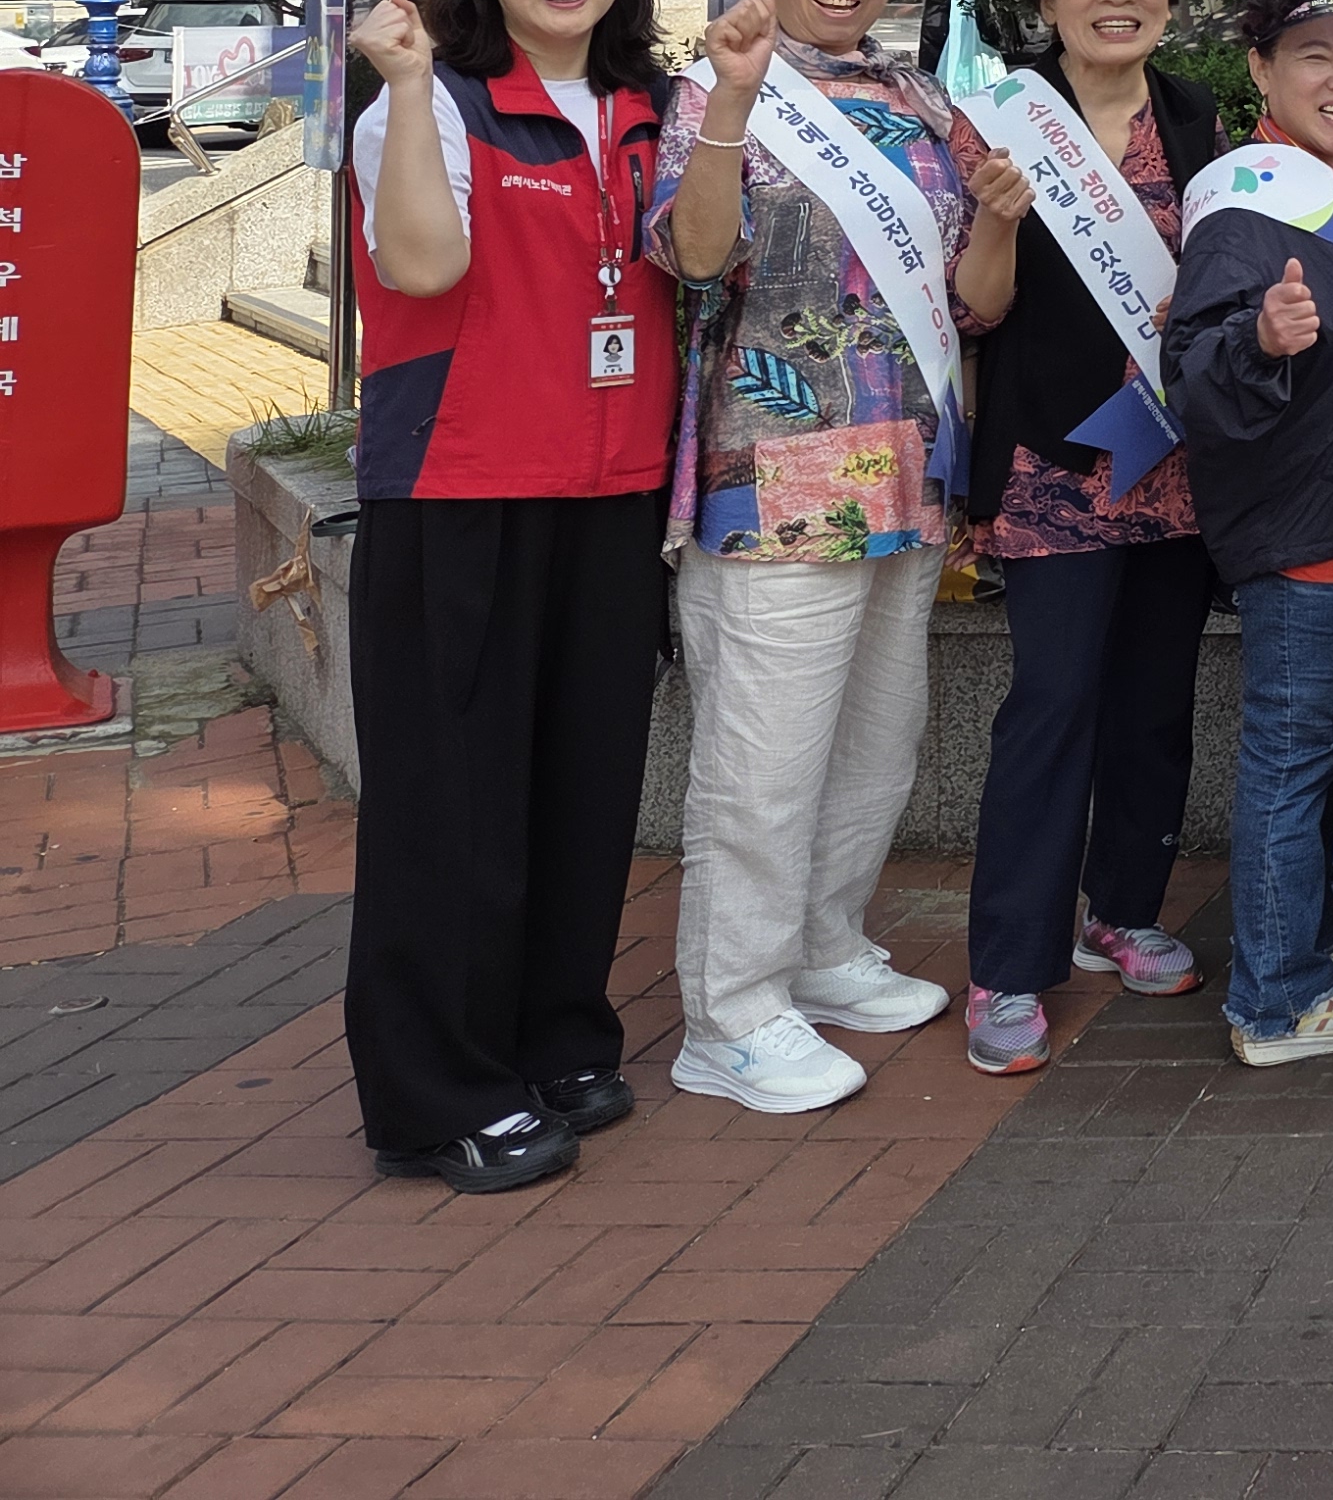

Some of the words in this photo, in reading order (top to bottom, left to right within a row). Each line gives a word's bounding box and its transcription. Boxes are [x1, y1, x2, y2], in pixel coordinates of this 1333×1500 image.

[757, 80, 850, 169] 자살예방
[849, 169, 927, 276] 상담전화
[921, 282, 950, 356] 109
[1027, 101, 1086, 169] 소중한
[1080, 169, 1125, 223] 생명
[1028, 155, 1078, 208] 지킬
[1072, 214, 1097, 238] 수
